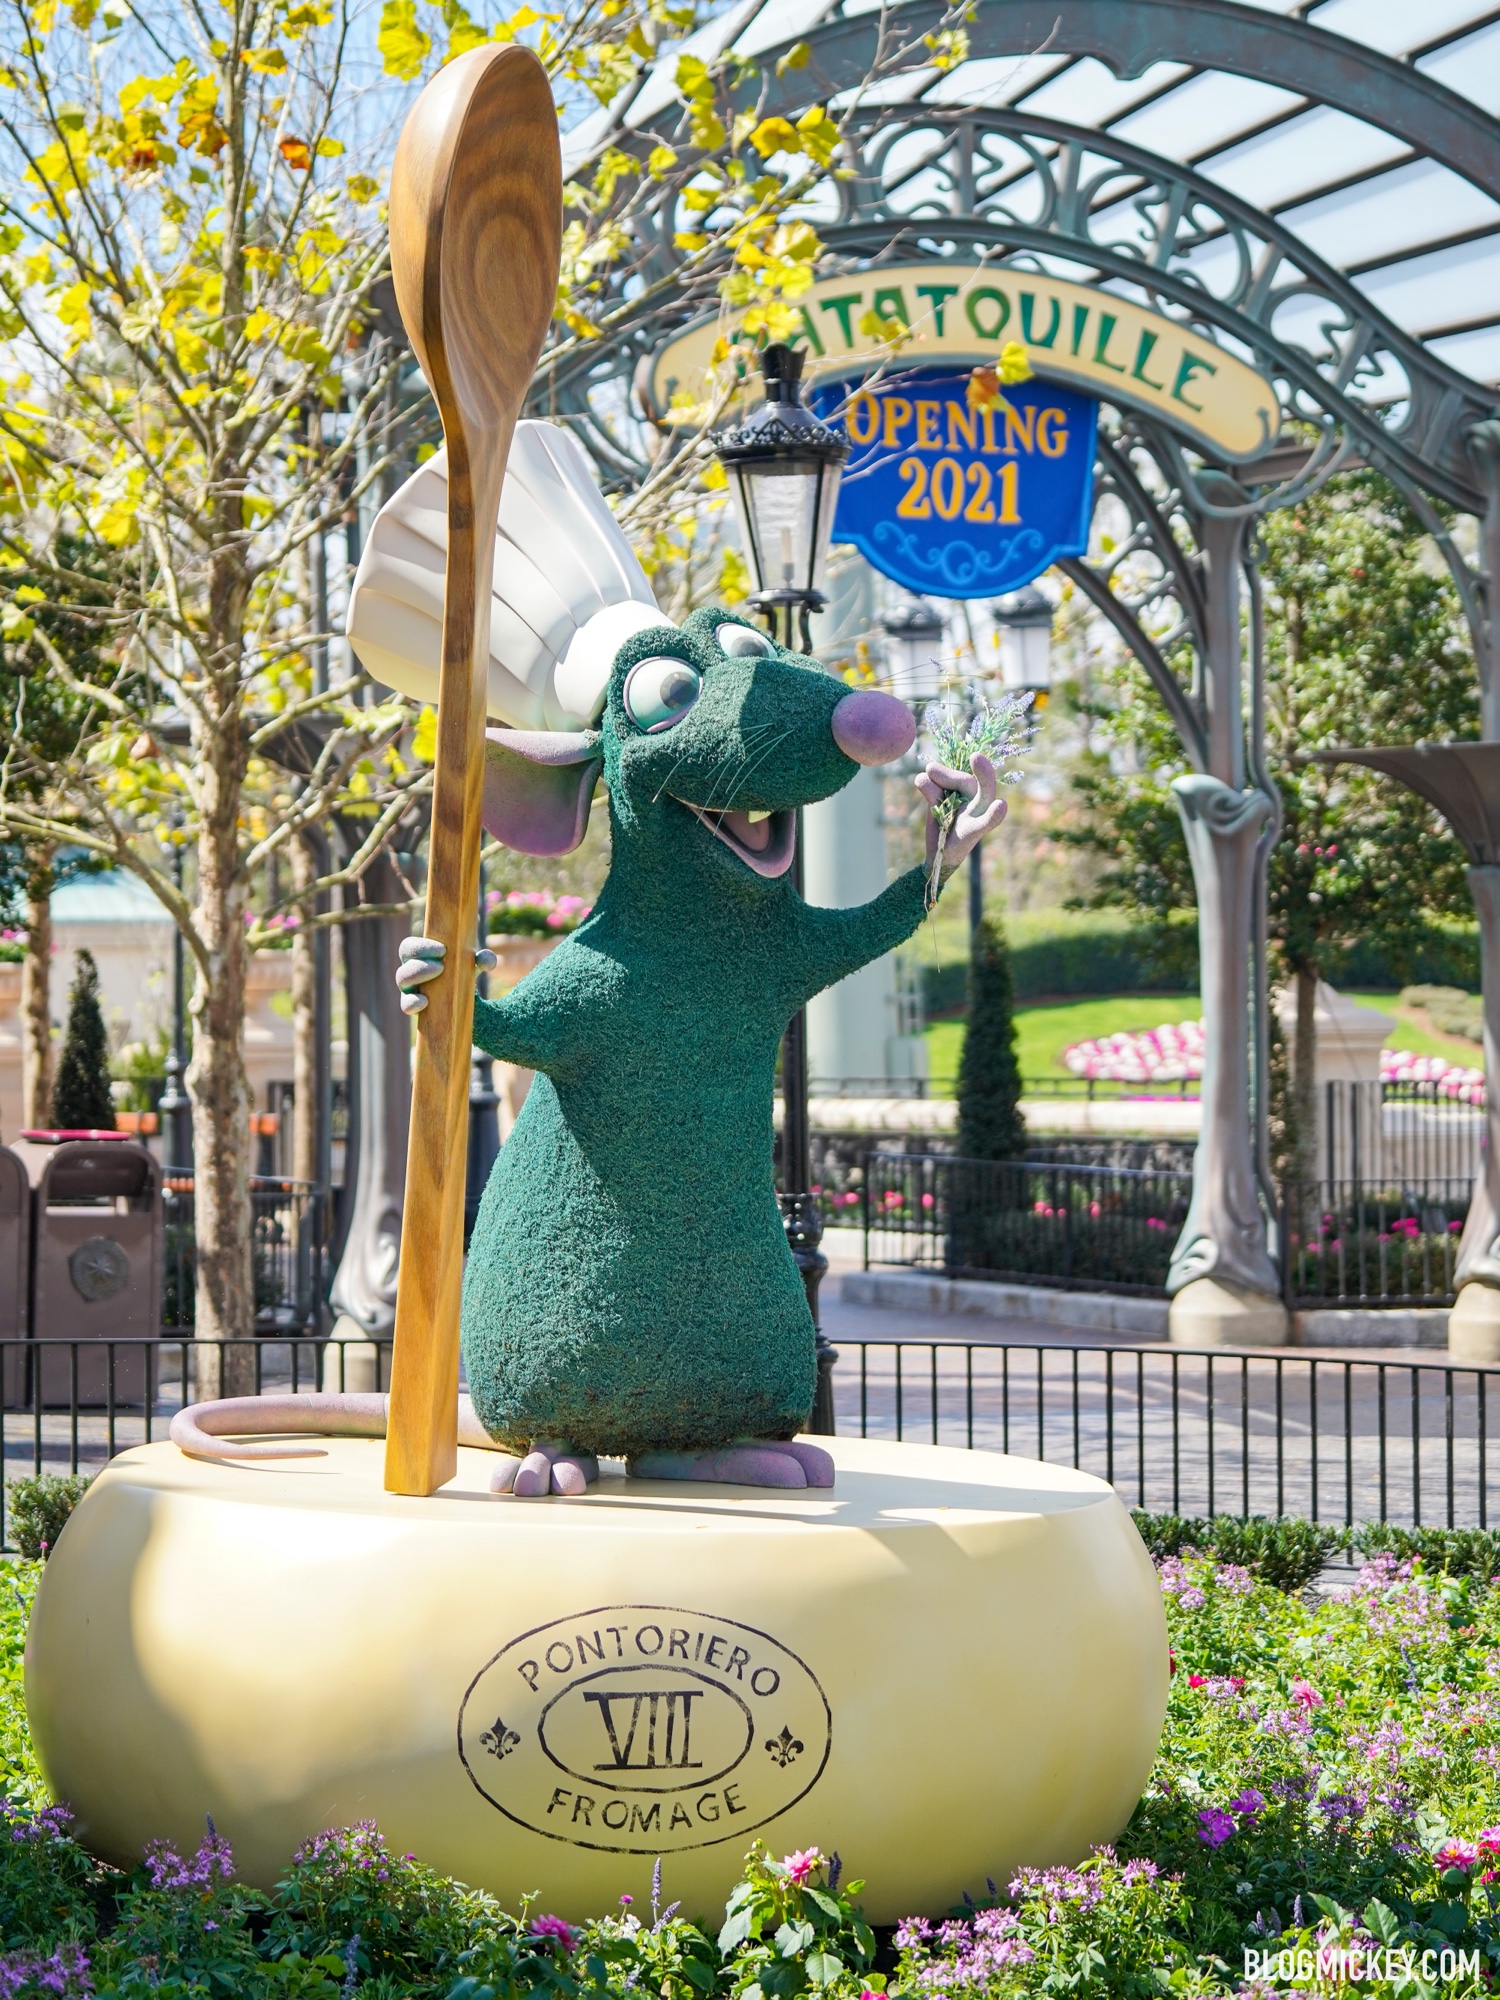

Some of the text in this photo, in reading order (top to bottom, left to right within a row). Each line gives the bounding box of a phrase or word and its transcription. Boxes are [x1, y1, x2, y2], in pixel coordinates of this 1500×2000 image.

[731, 284, 1218, 413] ATATOUILLE
[846, 391, 1068, 457] OPENING
[896, 456, 1022, 525] 2021
[517, 1624, 781, 1697] PONTORIERO
[582, 1690, 704, 1771] VIII
[546, 1783, 747, 1833] FROMAGE
